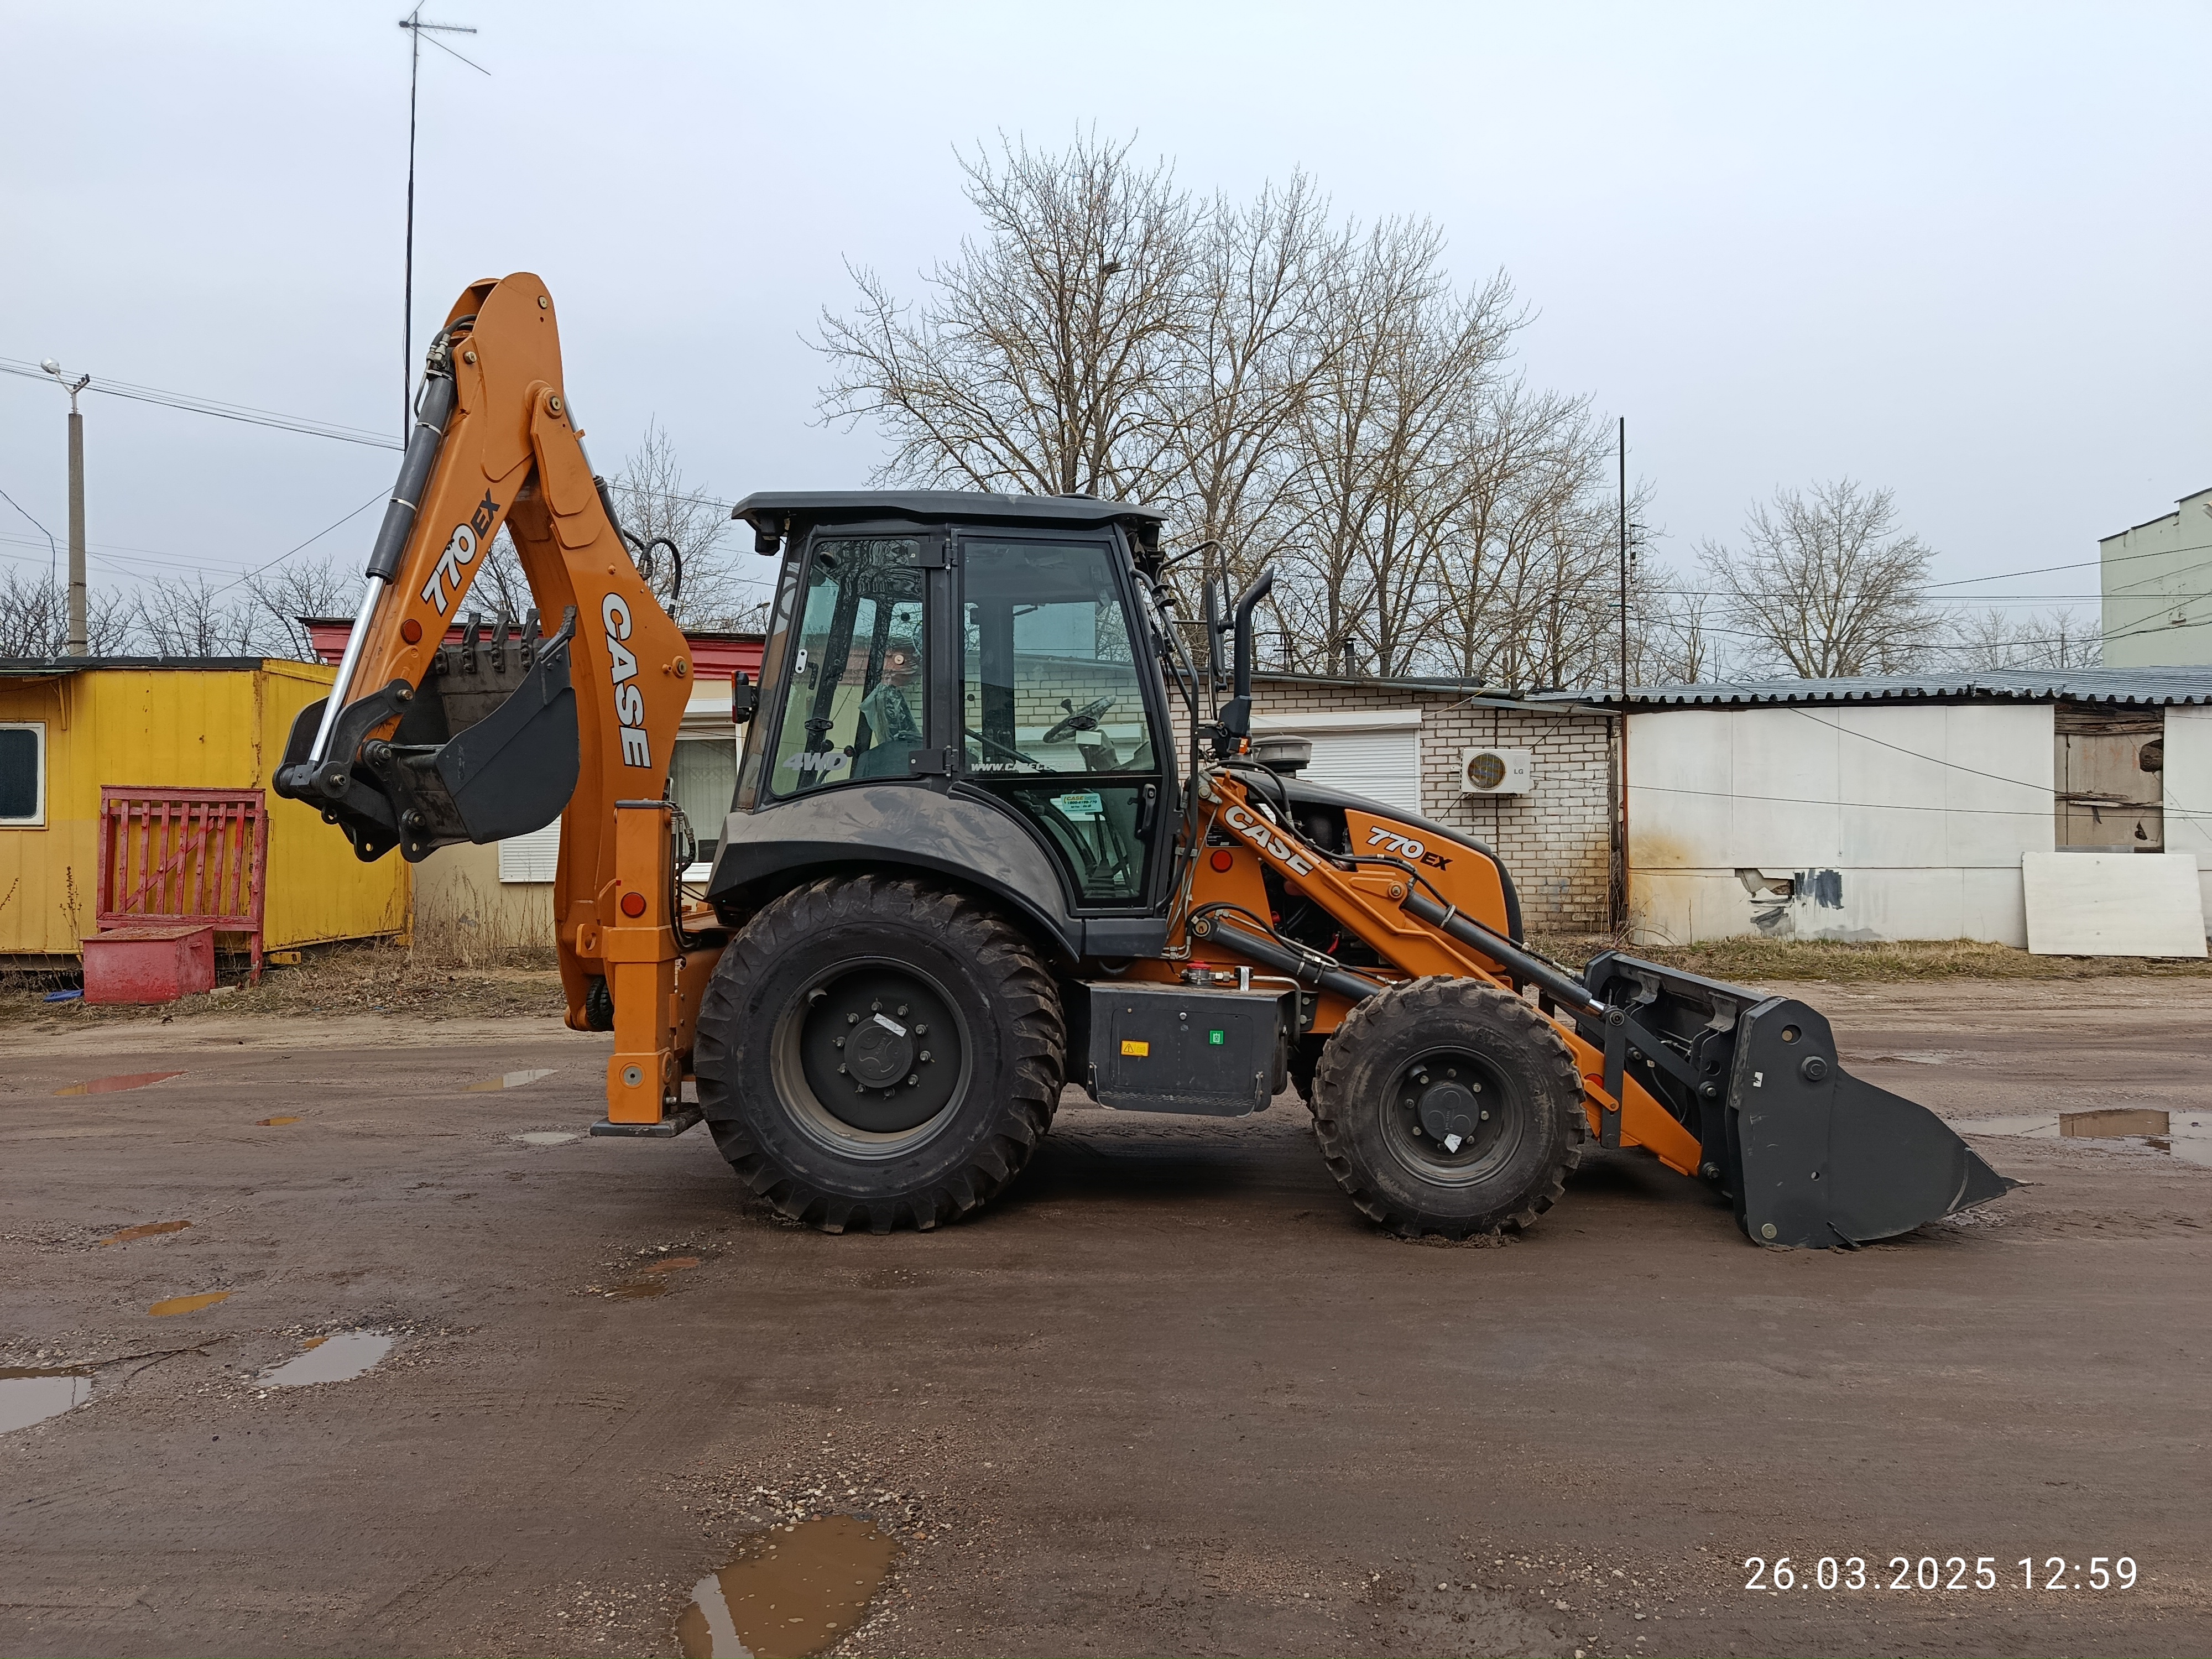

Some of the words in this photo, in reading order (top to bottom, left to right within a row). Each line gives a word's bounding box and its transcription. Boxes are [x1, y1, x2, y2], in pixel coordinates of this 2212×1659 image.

[420, 523, 477, 617] 770
[471, 488, 500, 540] EX
[602, 592, 652, 769] CASE
[782, 752, 847, 771] 4WD
[1224, 805, 1322, 877] CASE
[1365, 826, 1425, 859] 770
[1420, 851, 1453, 872] EX
